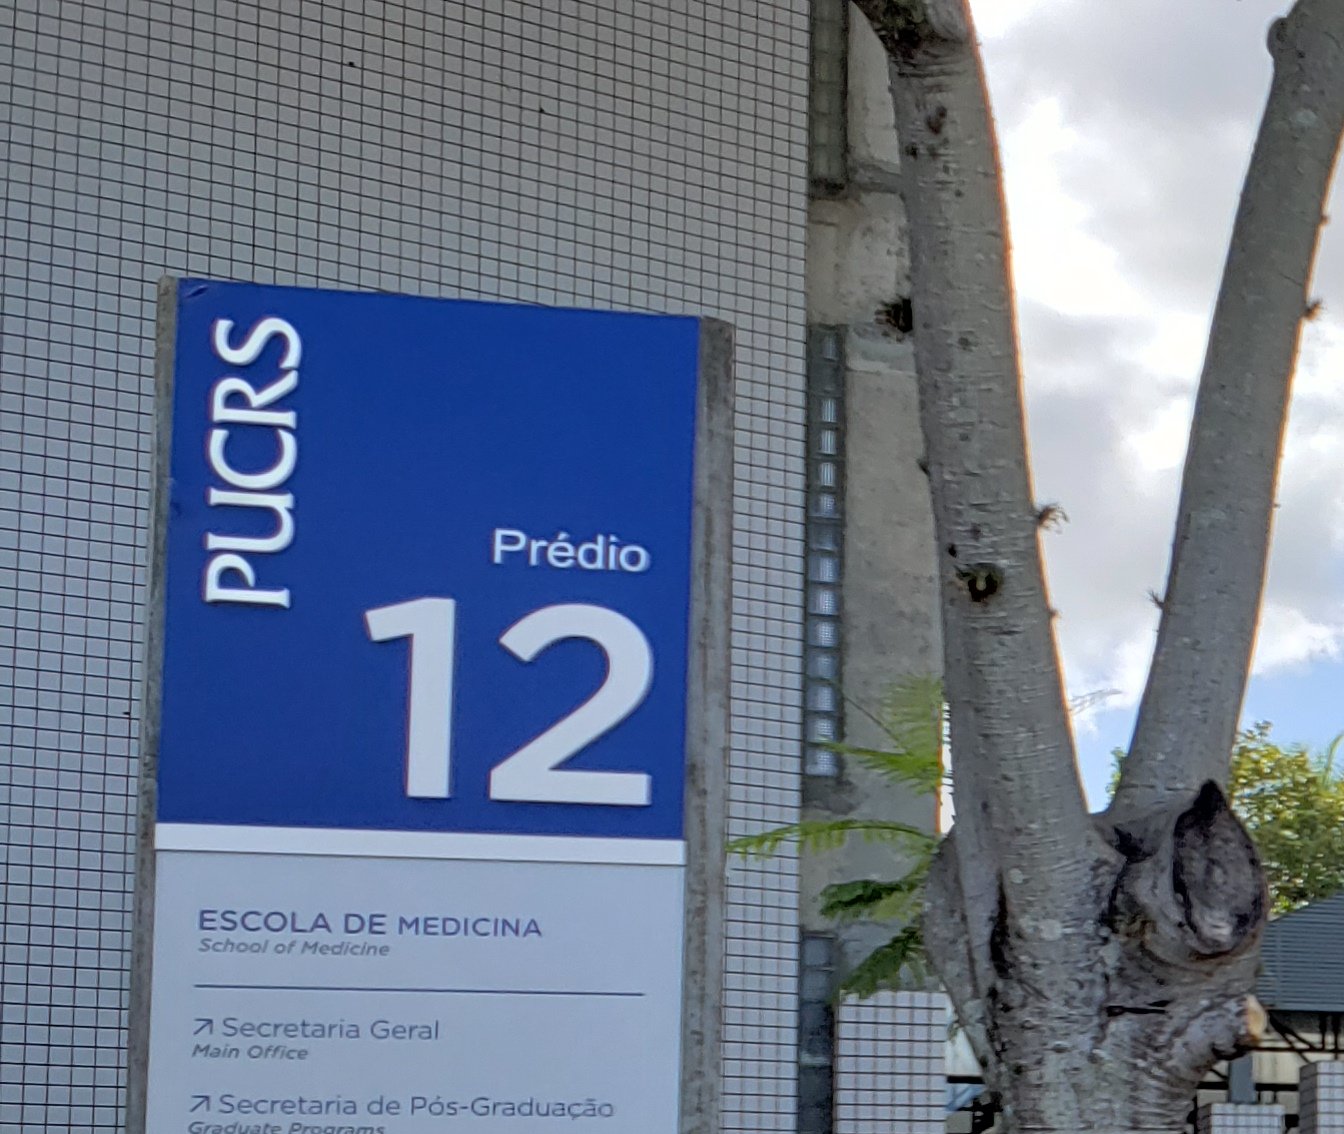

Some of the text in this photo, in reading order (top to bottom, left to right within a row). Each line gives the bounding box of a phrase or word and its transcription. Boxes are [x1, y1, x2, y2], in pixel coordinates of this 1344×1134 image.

[204, 316, 301, 608] PUCRS
[494, 529, 650, 571] Prédio
[366, 598, 652, 804] 12
[199, 910, 542, 937] ESCOLA DE MEDICINA
[198, 938, 390, 956] School of Medicine
[222, 1017, 438, 1040] Secretaria Geral
[192, 1044, 308, 1060] Main Office
[219, 1094, 613, 1120] Secretaria de Pós-Graduação
[188, 1121, 282, 1134] Graduate
